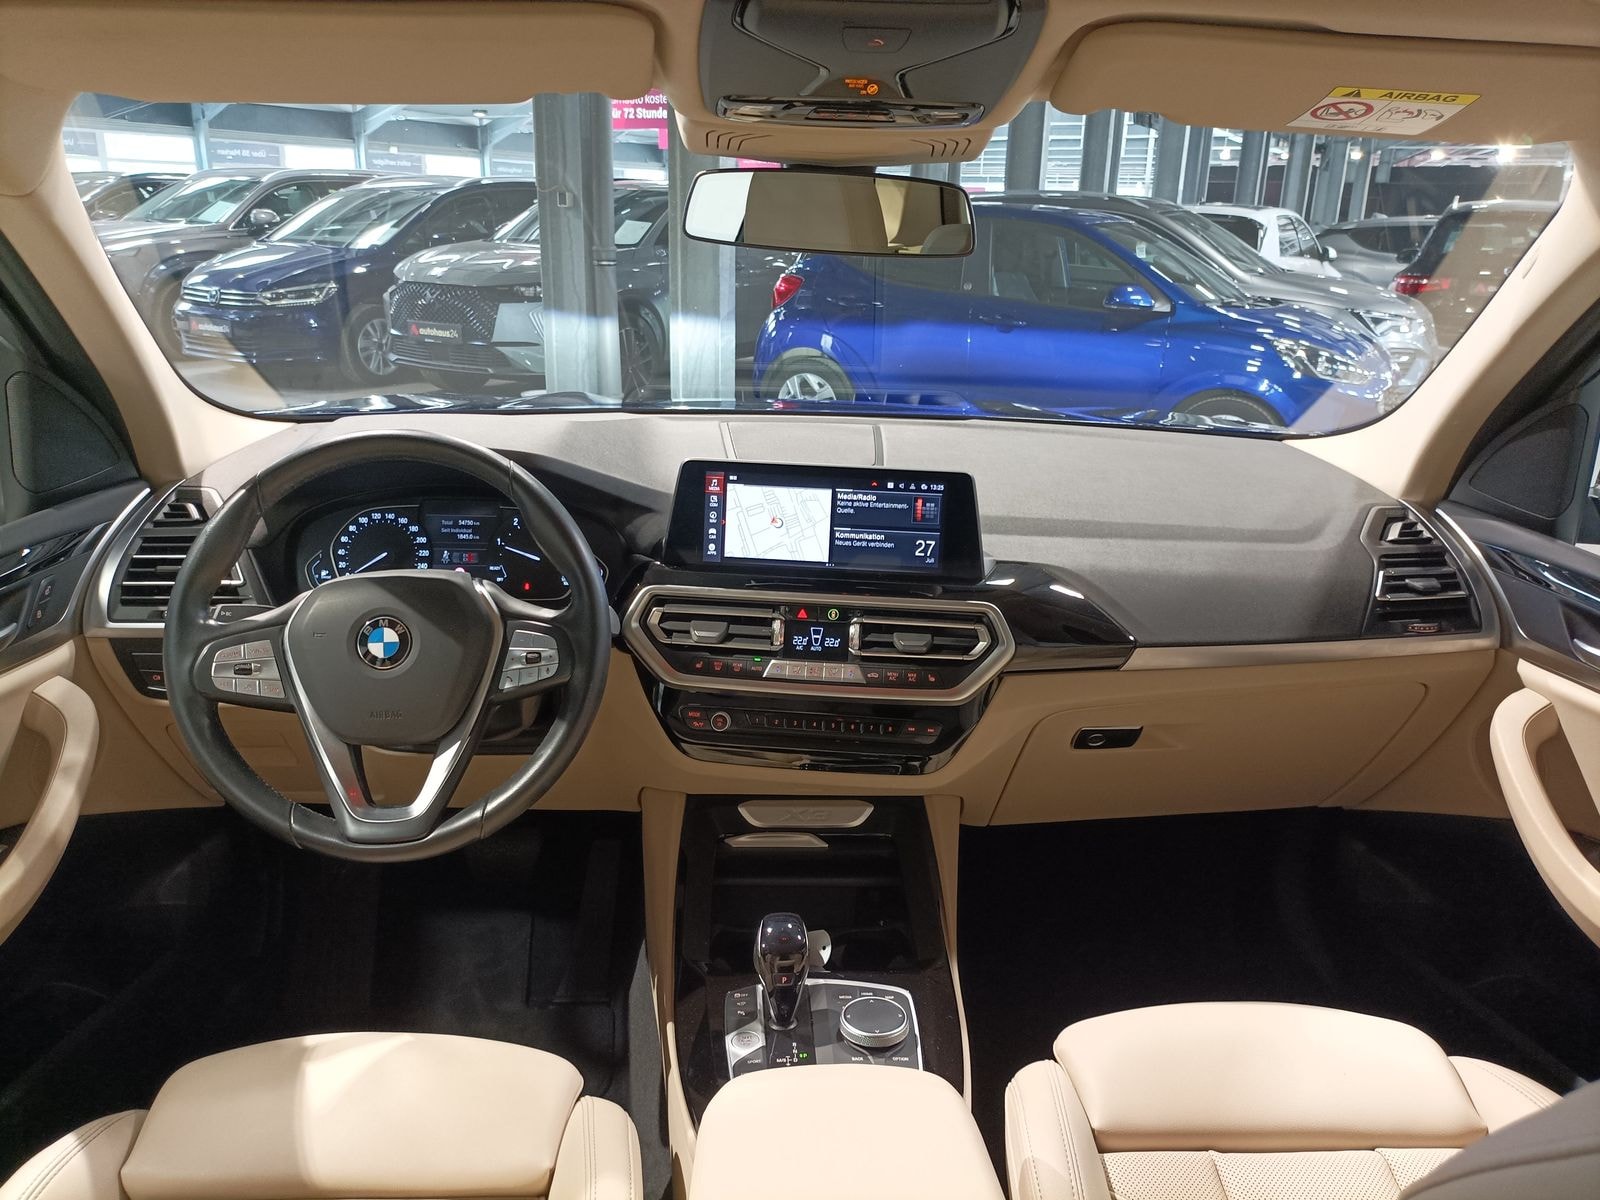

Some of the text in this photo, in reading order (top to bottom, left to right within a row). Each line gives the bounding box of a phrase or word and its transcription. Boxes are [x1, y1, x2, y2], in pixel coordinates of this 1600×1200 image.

[1378, 91, 1460, 104] AIRBAG
[623, 108, 635, 119] 72
[420, 328, 459, 338] autohaus24
[837, 492, 877, 501] Media/Radio
[870, 502, 909, 510] Entertainment-
[513, 518, 519, 526] 2
[835, 531, 885, 541] Kommunikation
[834, 539, 895, 549] Neues Gerät verbinden
[914, 539, 936, 557] 27
[363, 619, 405, 636] BMW
[369, 711, 403, 720] AIRBAG
[782, 976, 787, 984] P
